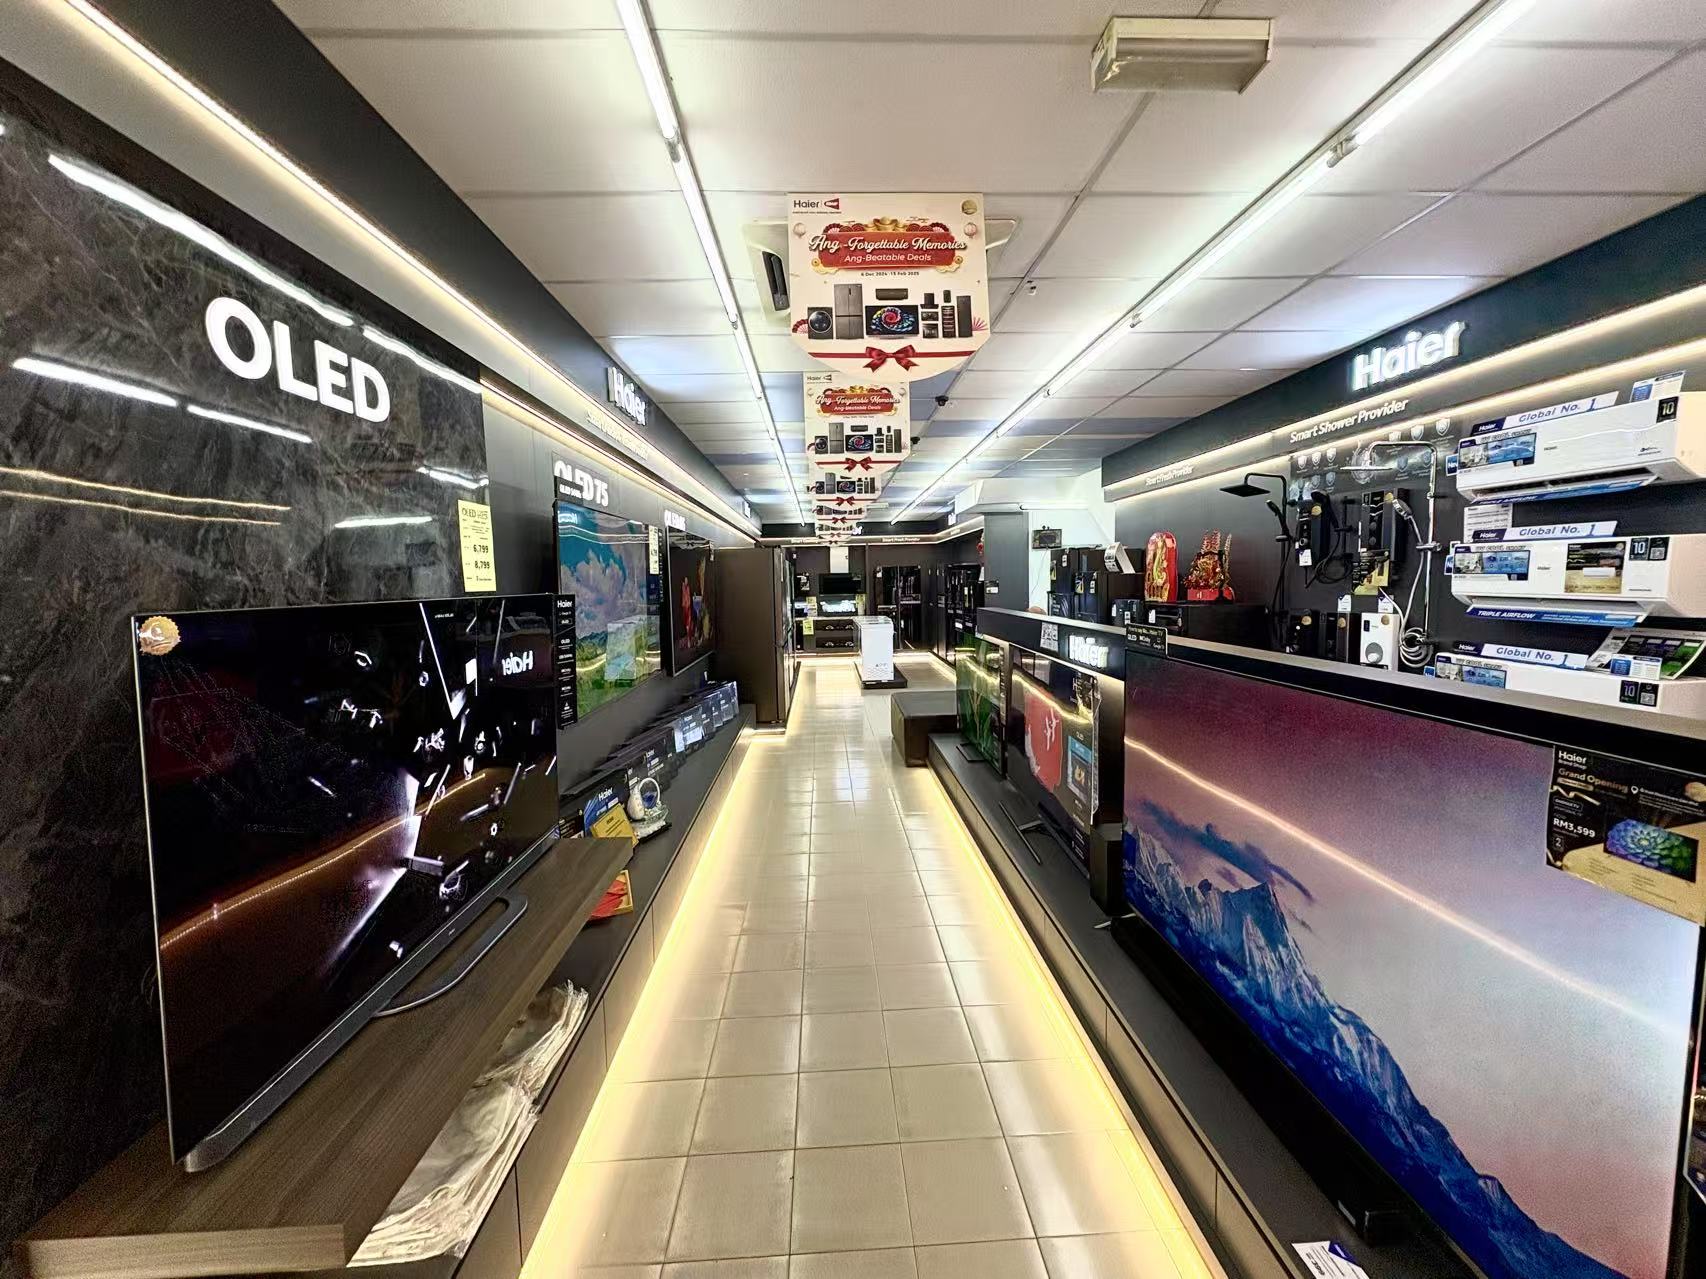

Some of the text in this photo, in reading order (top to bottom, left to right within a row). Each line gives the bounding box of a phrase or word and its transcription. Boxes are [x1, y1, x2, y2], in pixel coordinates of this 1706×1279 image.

[793, 200, 820, 208] Haier
[808, 234, 840, 253] Ang
[911, 236, 967, 251] Memories
[844, 253, 932, 264] Ang-Beatable Deals
[205, 296, 391, 423] OLED
[1351, 320, 1467, 391] Haier
[607, 366, 646, 426] Haier
[1478, 398, 1597, 432] Haier Global No. 1
[1662, 401, 1675, 416] 10
[1289, 400, 1409, 444] Smart Shower Provider
[1479, 524, 1596, 539] Haier Global No. 1
[1633, 541, 1646, 554] 10
[557, 599, 573, 608] Haier
[1069, 634, 1109, 668] Haier
[1458, 643, 1476, 651] Haier
[1496, 646, 1532, 659] Global
[1535, 651, 1555, 661] No.
[1624, 685, 1636, 698] 10
[1558, 750, 1587, 764] Haier
[1558, 767, 1586, 781] Grand
[1586, 775, 1629, 794] Opening
[1553, 817, 1596, 838] RM3,599
